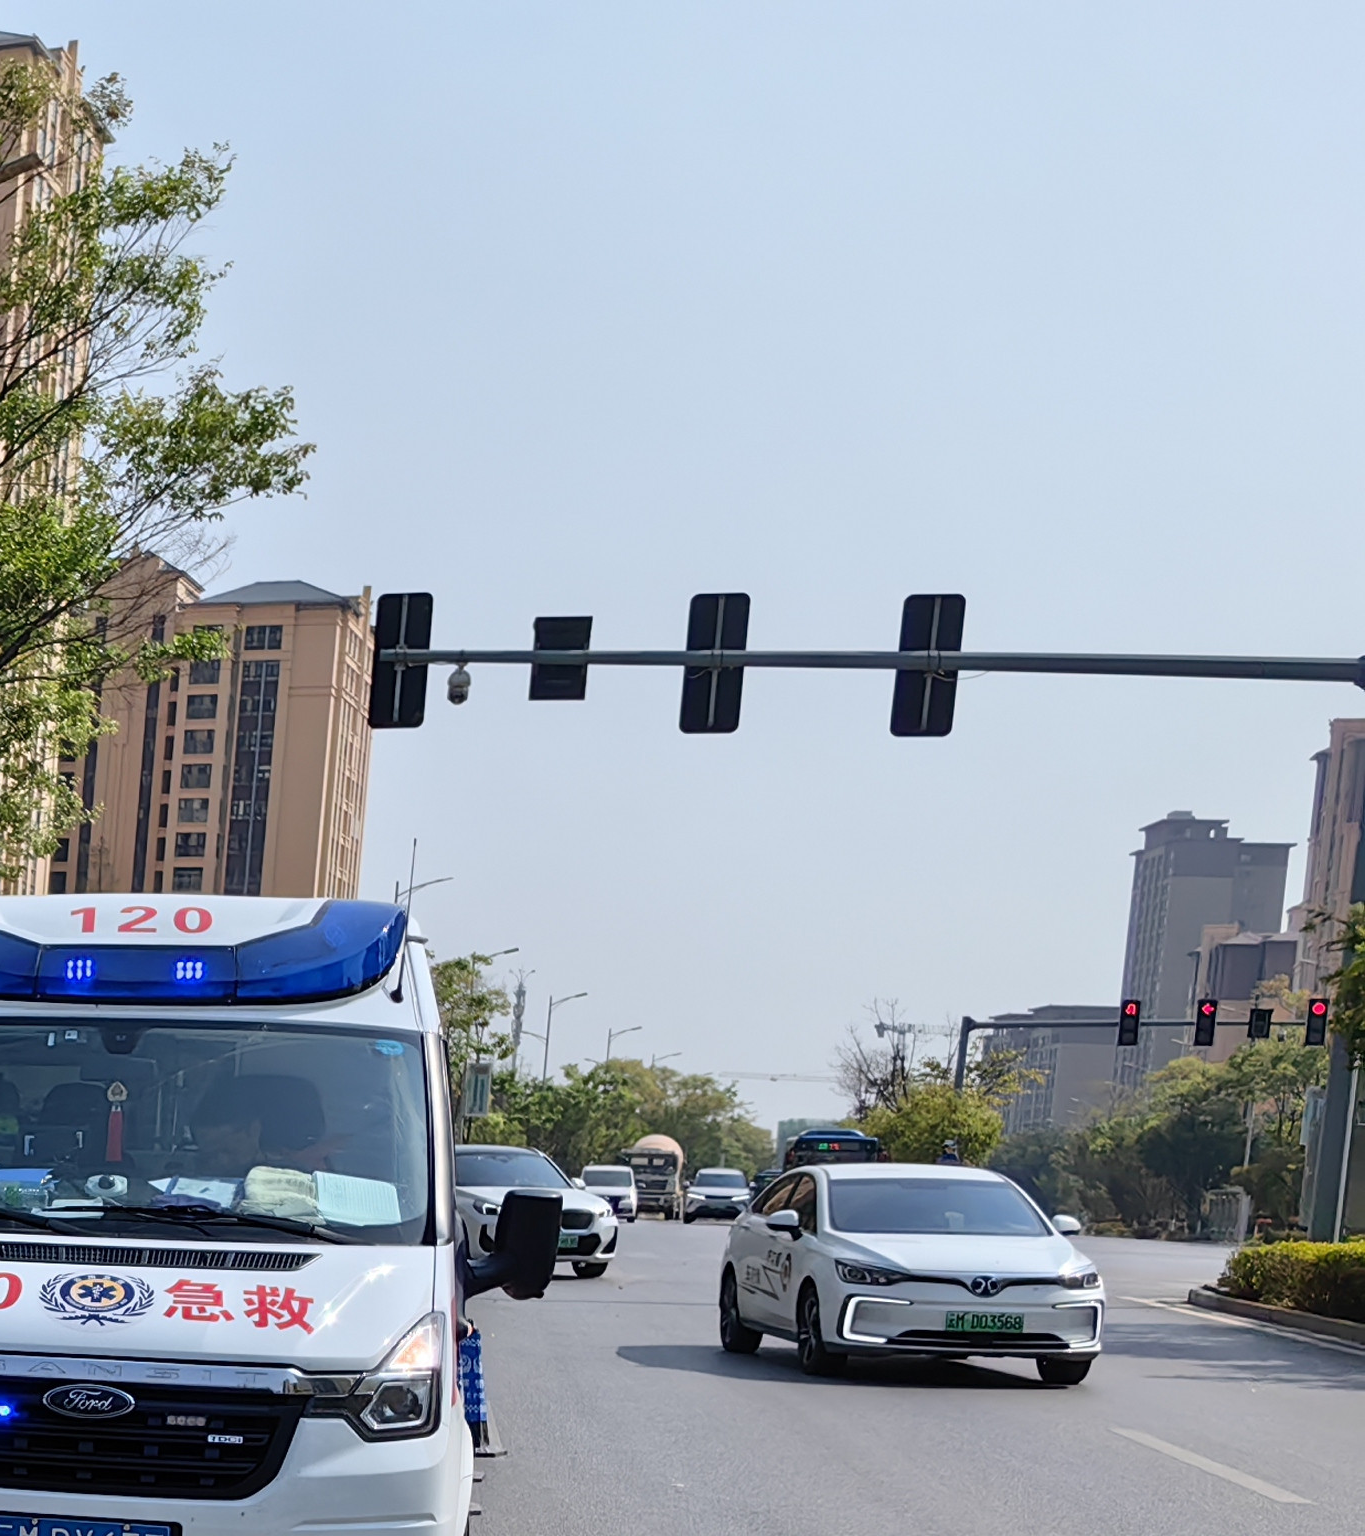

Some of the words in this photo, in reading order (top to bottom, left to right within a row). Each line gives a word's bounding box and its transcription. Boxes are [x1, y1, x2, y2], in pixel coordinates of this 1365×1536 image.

[70, 905, 213, 934] 120
[163, 1278, 315, 1335] 急救
[61, 1388, 114, 1413] Ford
